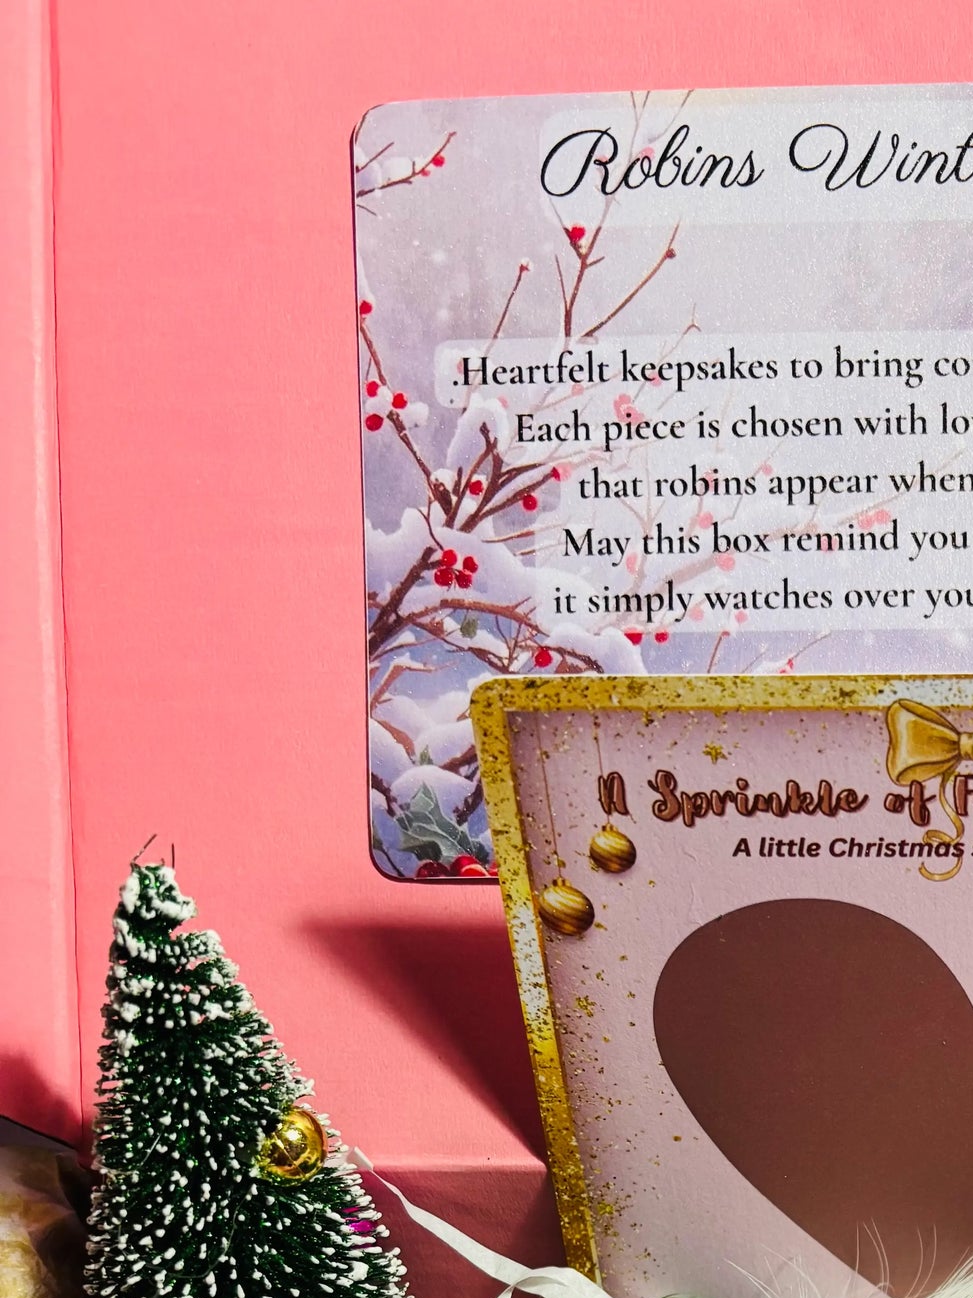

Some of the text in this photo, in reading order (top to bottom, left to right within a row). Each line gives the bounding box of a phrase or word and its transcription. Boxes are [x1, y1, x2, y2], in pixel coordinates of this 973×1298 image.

[540, 125, 765, 197] Robins
[621, 348, 779, 392] keepsakes
[790, 356, 823, 379] to
[835, 346, 923, 386] bring
[515, 412, 591, 443] Each
[604, 416, 685, 450] piece
[698, 415, 721, 439] is
[730, 406, 842, 439] chosen
[854, 403, 927, 436] with
[579, 467, 643, 499] that
[655, 464, 757, 497] robins
[768, 471, 879, 505] appear
[562, 527, 631, 566] May
[642, 523, 700, 554] this
[712, 521, 769, 554] box
[782, 516, 899, 552] remind
[909, 525, 968, 560] you
[554, 586, 576, 615] it
[588, 580, 692, 625] simply
[704, 579, 833, 611] watches
[844, 588, 914, 609] over
[648, 768, 869, 826] Sprinkle
[883, 777, 933, 826] of
[732, 838, 752, 859] A
[758, 836, 821, 859] little
[829, 836, 964, 859] Christmas
